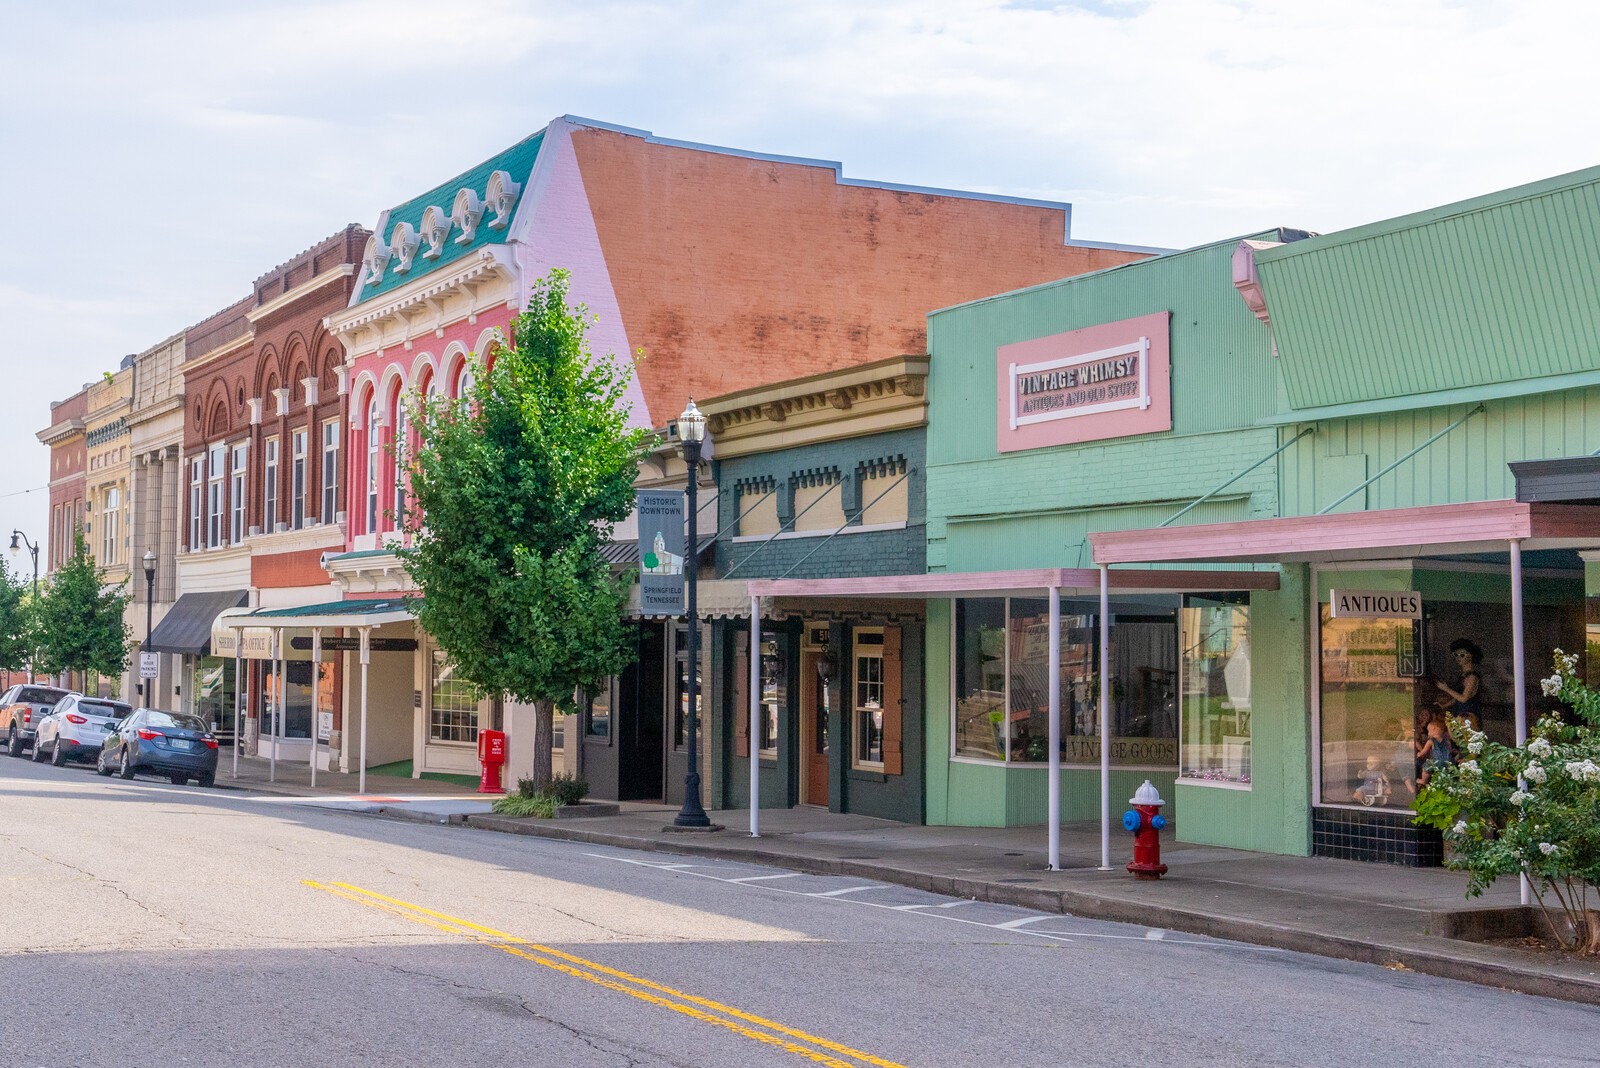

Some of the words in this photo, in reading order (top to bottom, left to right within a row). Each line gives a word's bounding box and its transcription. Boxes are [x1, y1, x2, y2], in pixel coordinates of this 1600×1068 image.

[1019, 370, 1078, 395] VINTAGE
[1079, 356, 1136, 385] WHIMSY
[1023, 394, 1064, 413] ANTIQUES
[1066, 390, 1086, 406] AND
[1087, 387, 1106, 402] OLD
[1108, 380, 1137, 399] STUFF
[643, 496, 677, 506] HISTORIC
[640, 506, 681, 515] DOWNTOWN
[643, 586, 682, 594] SPRINGFIELD
[646, 595, 680, 604] TENNESSEE
[1340, 595, 1417, 613] ANTIQUES
[249, 637, 266, 651] OFFICE
[1071, 741, 1127, 759] VINTGE
[1131, 742, 1175, 760] GOODS
